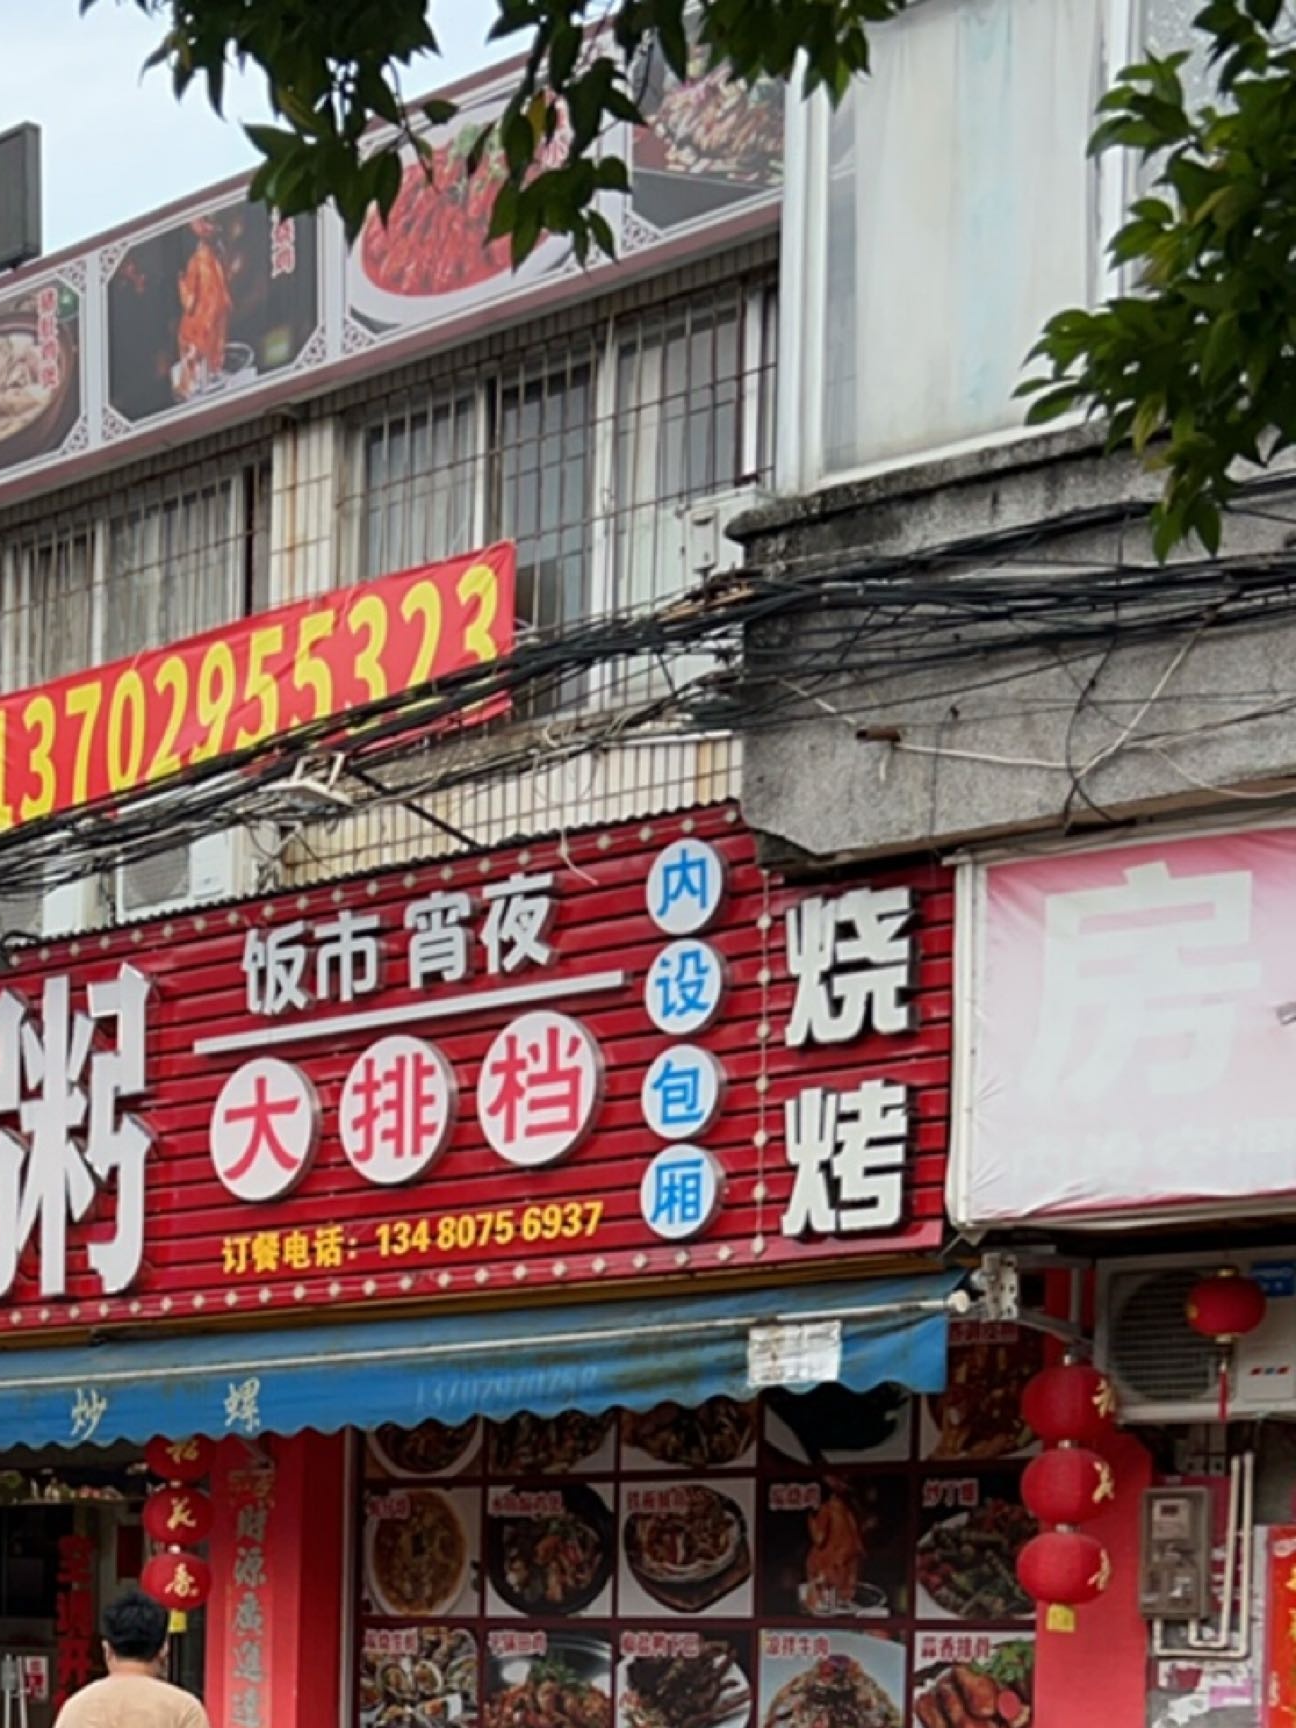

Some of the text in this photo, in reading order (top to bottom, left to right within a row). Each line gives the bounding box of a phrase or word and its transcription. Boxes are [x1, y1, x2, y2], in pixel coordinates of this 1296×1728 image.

[241, 873, 556, 1015] 饭市 宵夜
[650, 849, 714, 1227] 内设包厢
[1017, 860, 1264, 1097] 房
[223, 1025, 584, 1181] 大排档
[782, 885, 916, 1238] 烧烤
[375, 1219, 432, 1257] 134
[436, 1208, 515, 1251] 8075
[520, 1200, 604, 1242] 6937
